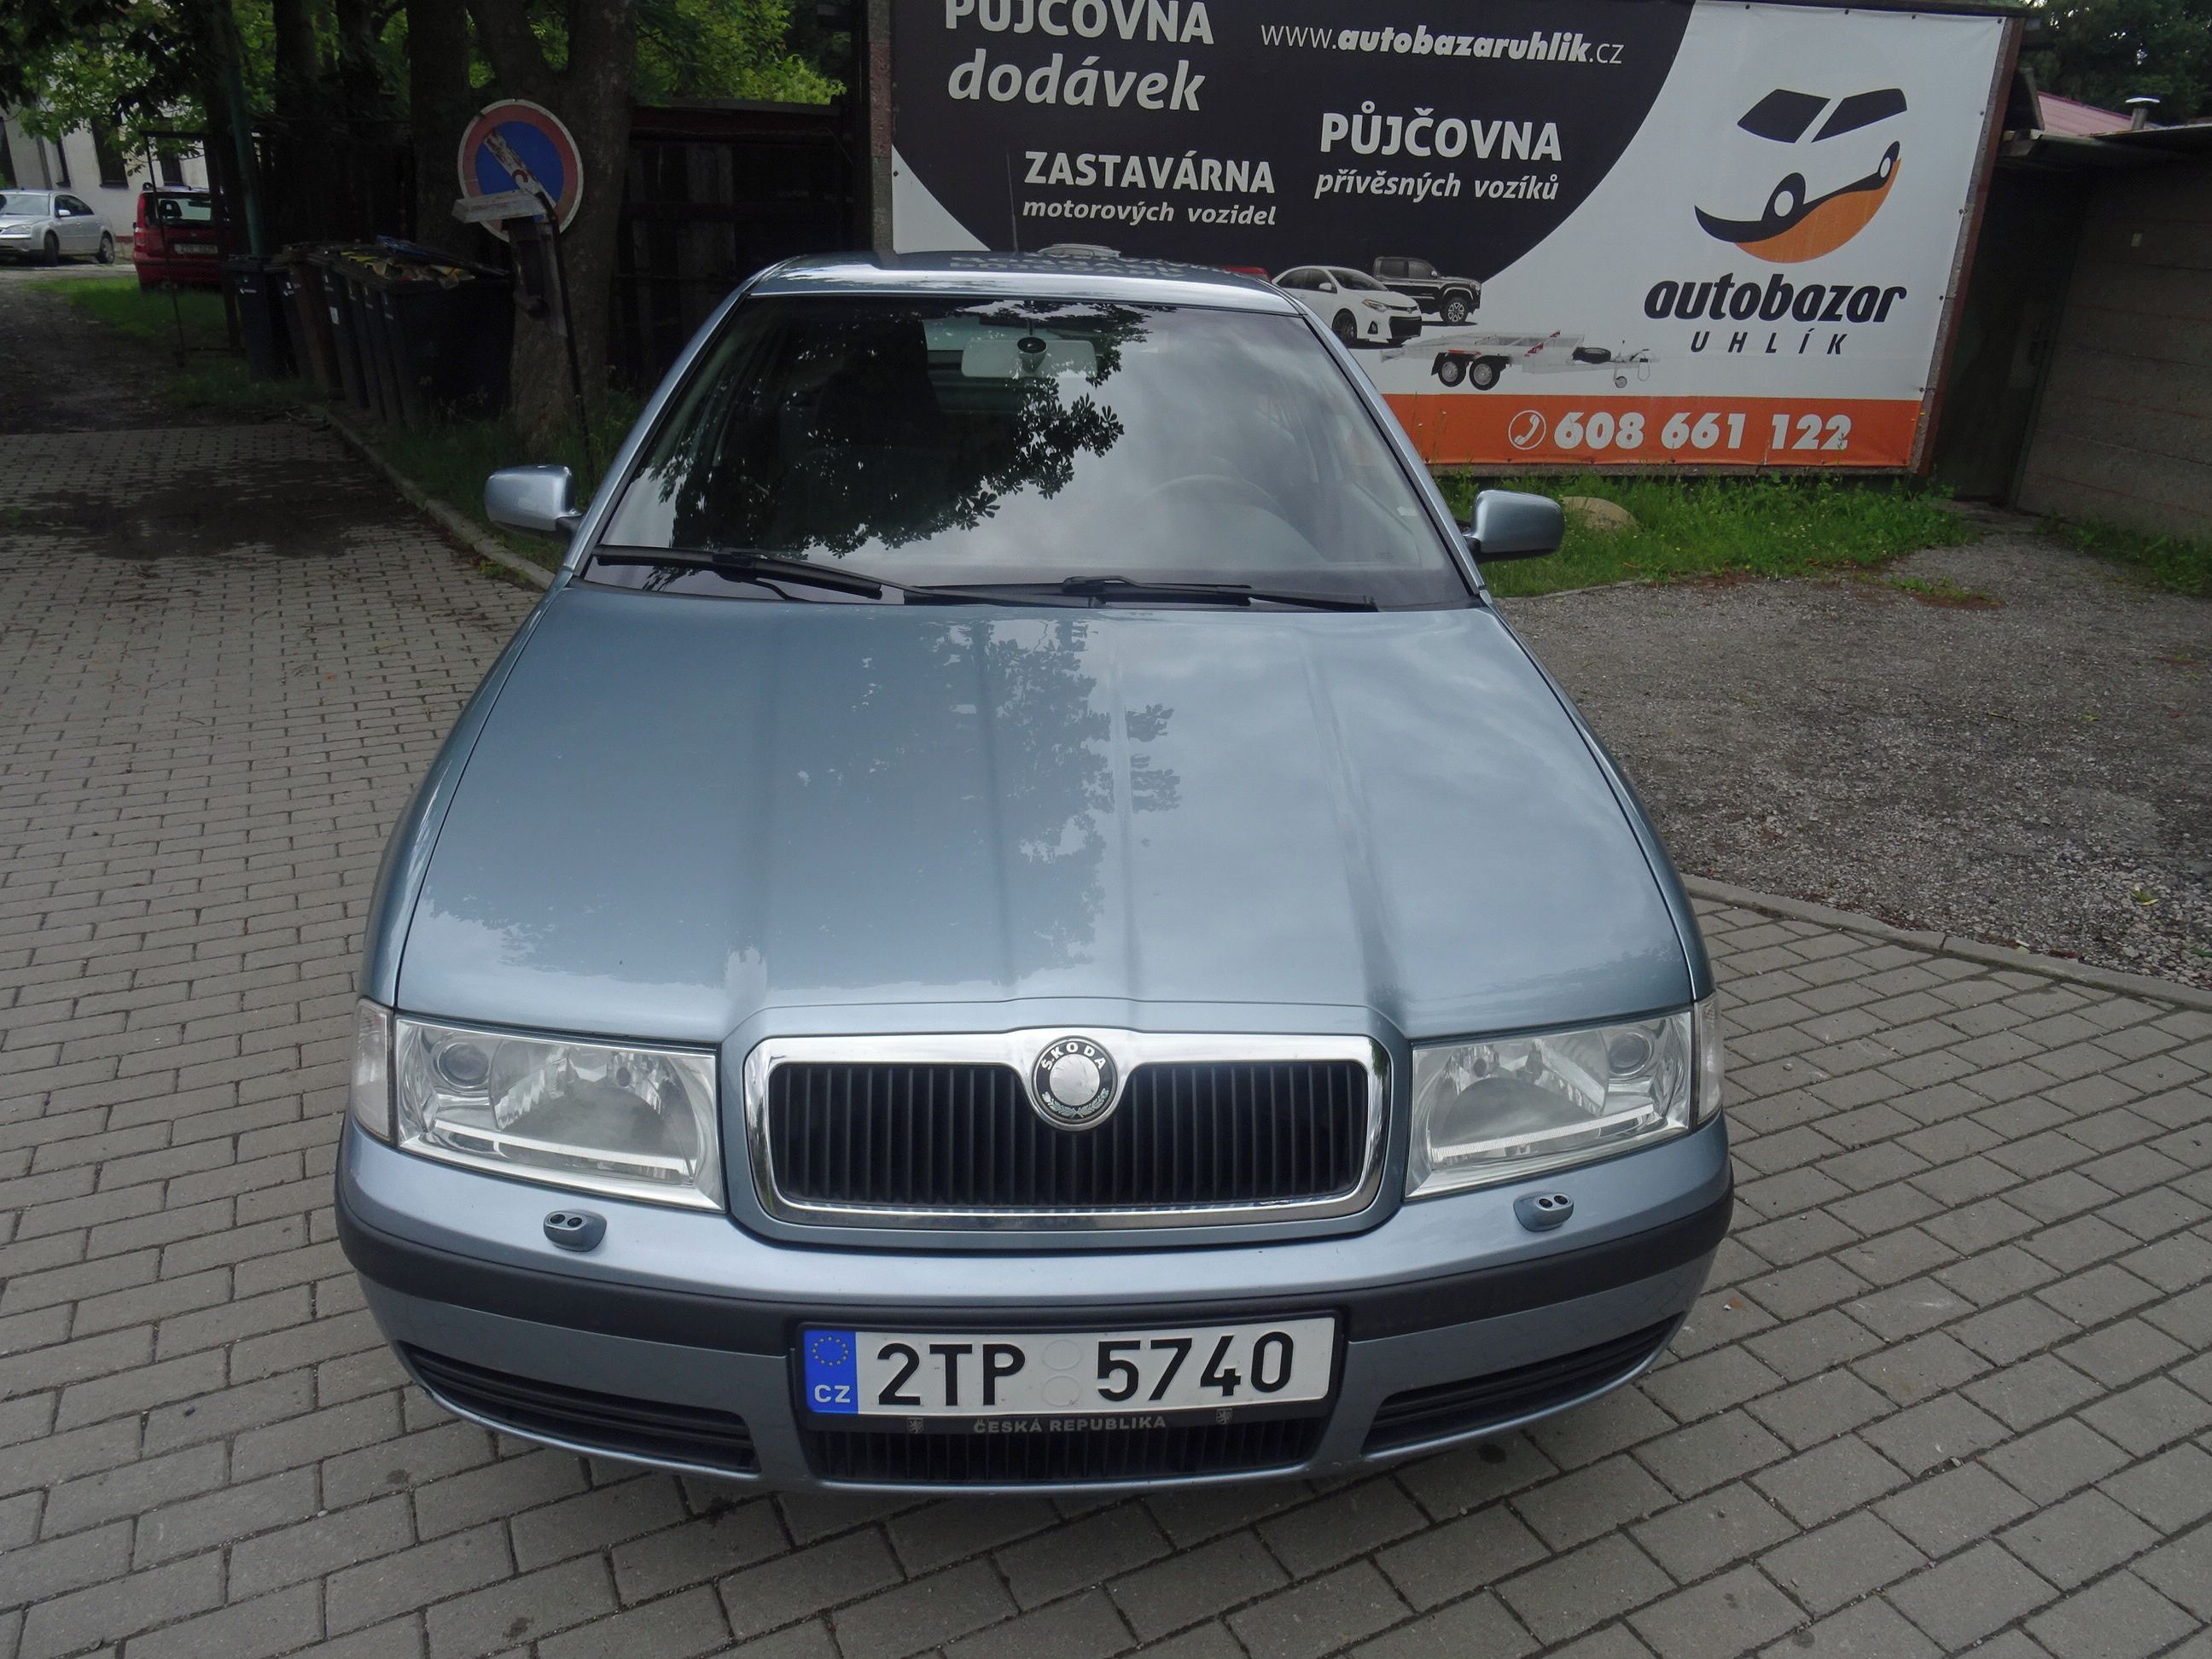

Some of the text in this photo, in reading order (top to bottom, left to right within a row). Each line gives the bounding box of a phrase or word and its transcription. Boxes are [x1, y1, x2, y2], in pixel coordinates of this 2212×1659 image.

[1260, 24, 1625, 65] www.autobazaruhlik.cz
[947, 48, 1206, 112] dodávek
[1319, 100, 1563, 162] PŮJČOVNA
[1023, 149, 1276, 195] ZASTAVÁRNA
[1313, 168, 1560, 203] přívěsných vozíků
[1022, 199, 1277, 226] motorových vozidel
[1644, 272, 1907, 323] autobazar
[1690, 328, 1848, 355] UHLÍK
[1553, 411, 1852, 451] 608 661 122
[876, 1330, 1295, 1407] 2TP 5740
[813, 1383, 851, 1405] CZ
[973, 1415, 1167, 1434] ČESKÁ REPUBLIKA
